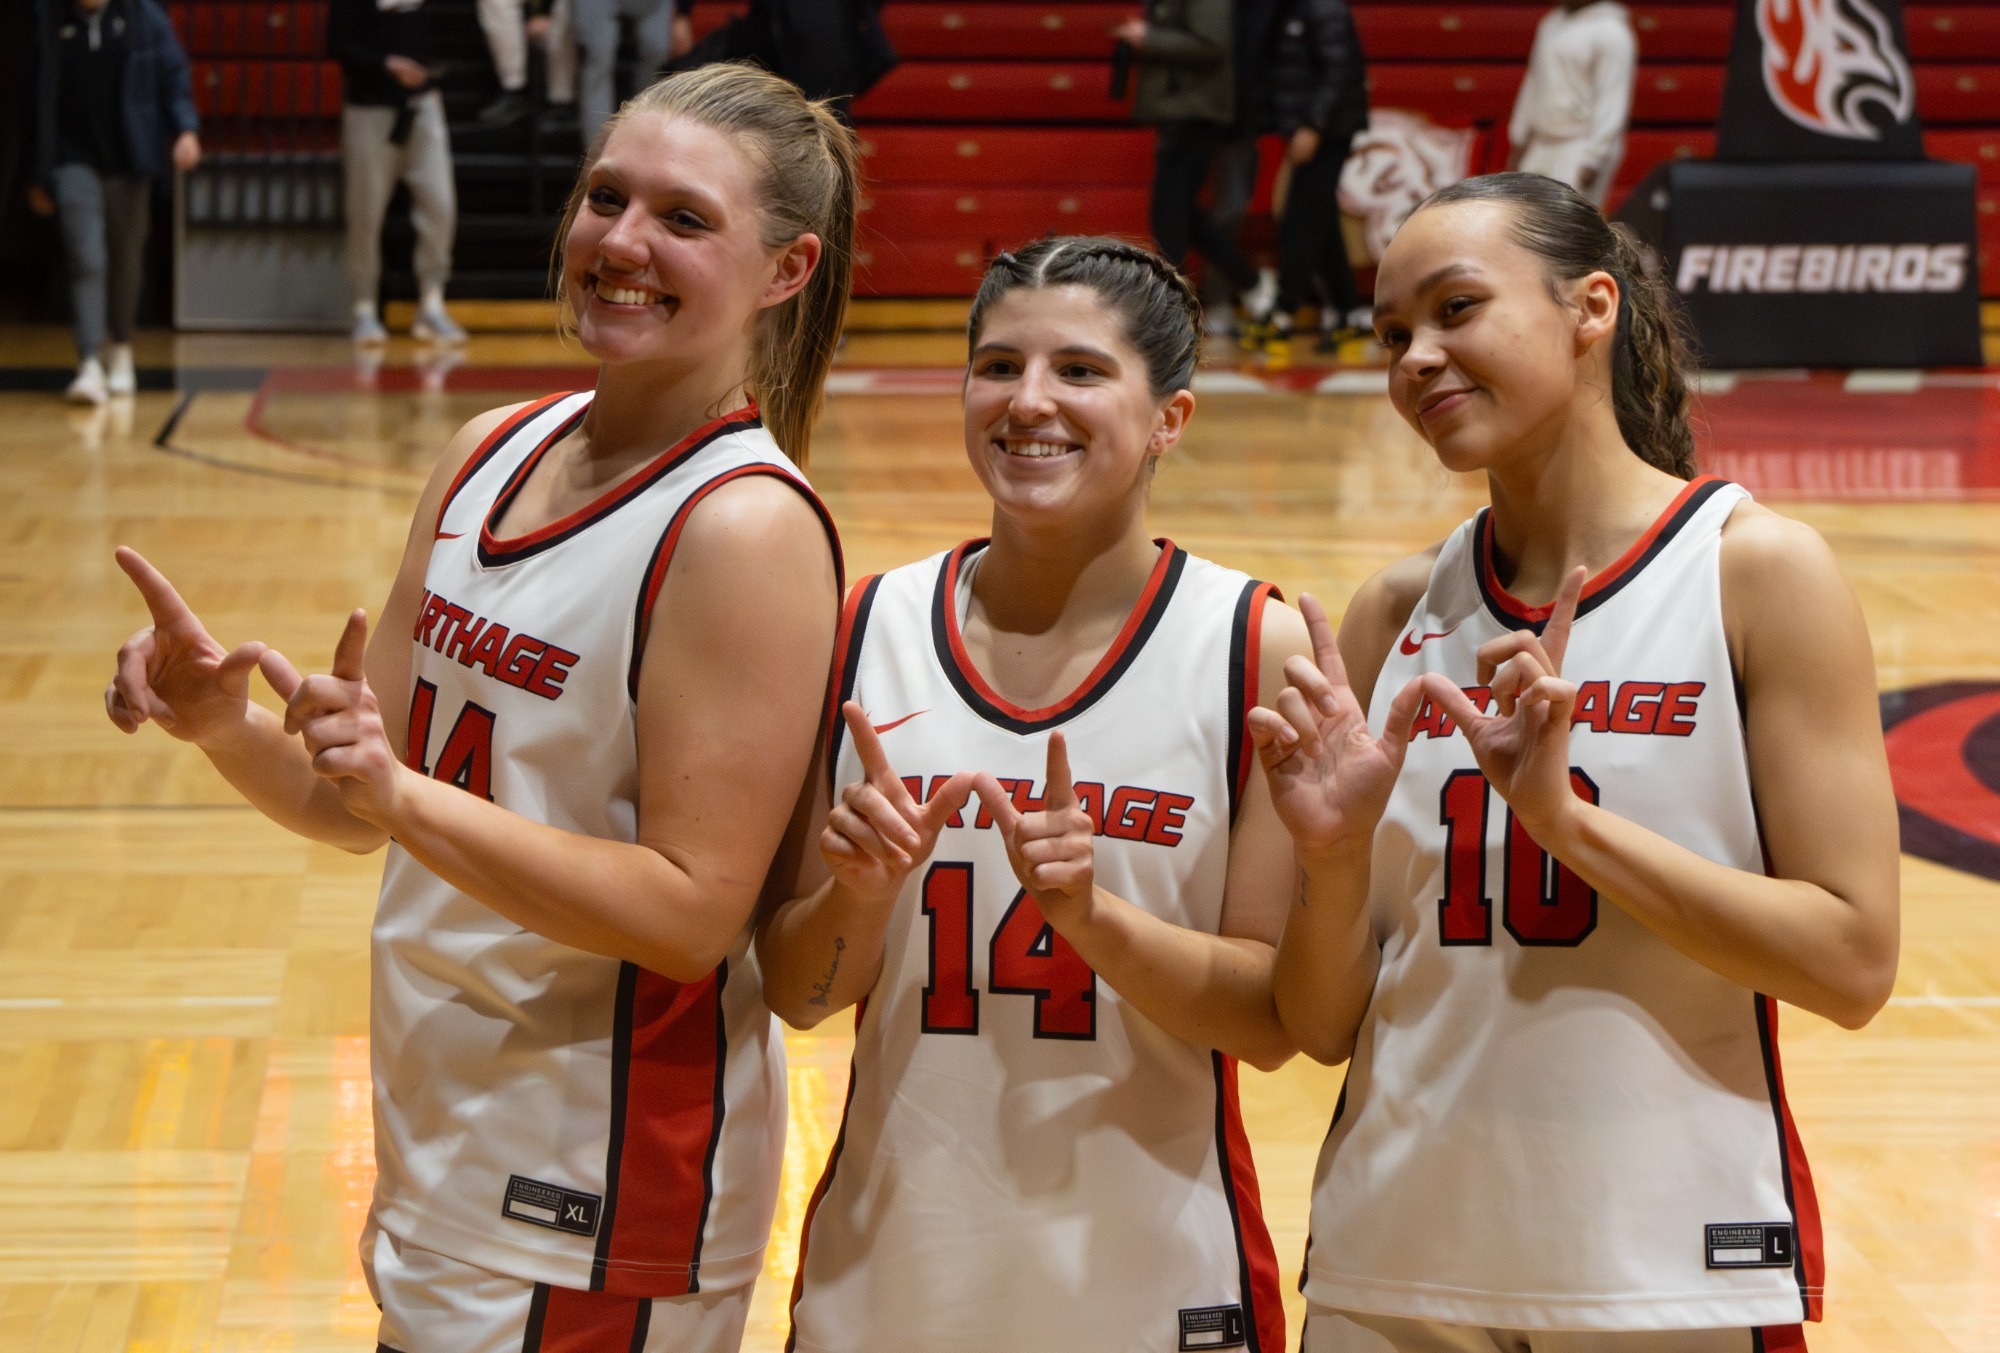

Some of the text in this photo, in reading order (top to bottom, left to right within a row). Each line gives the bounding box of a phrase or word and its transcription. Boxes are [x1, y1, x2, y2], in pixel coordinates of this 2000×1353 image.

[1676, 244, 1967, 293] FIREBIRDS
[1438, 766, 1600, 947] 10
[921, 861, 1097, 1041] 14
[564, 1203, 589, 1224] XL
[1774, 1236, 1783, 1254] L
[1232, 1318, 1239, 1335] L
